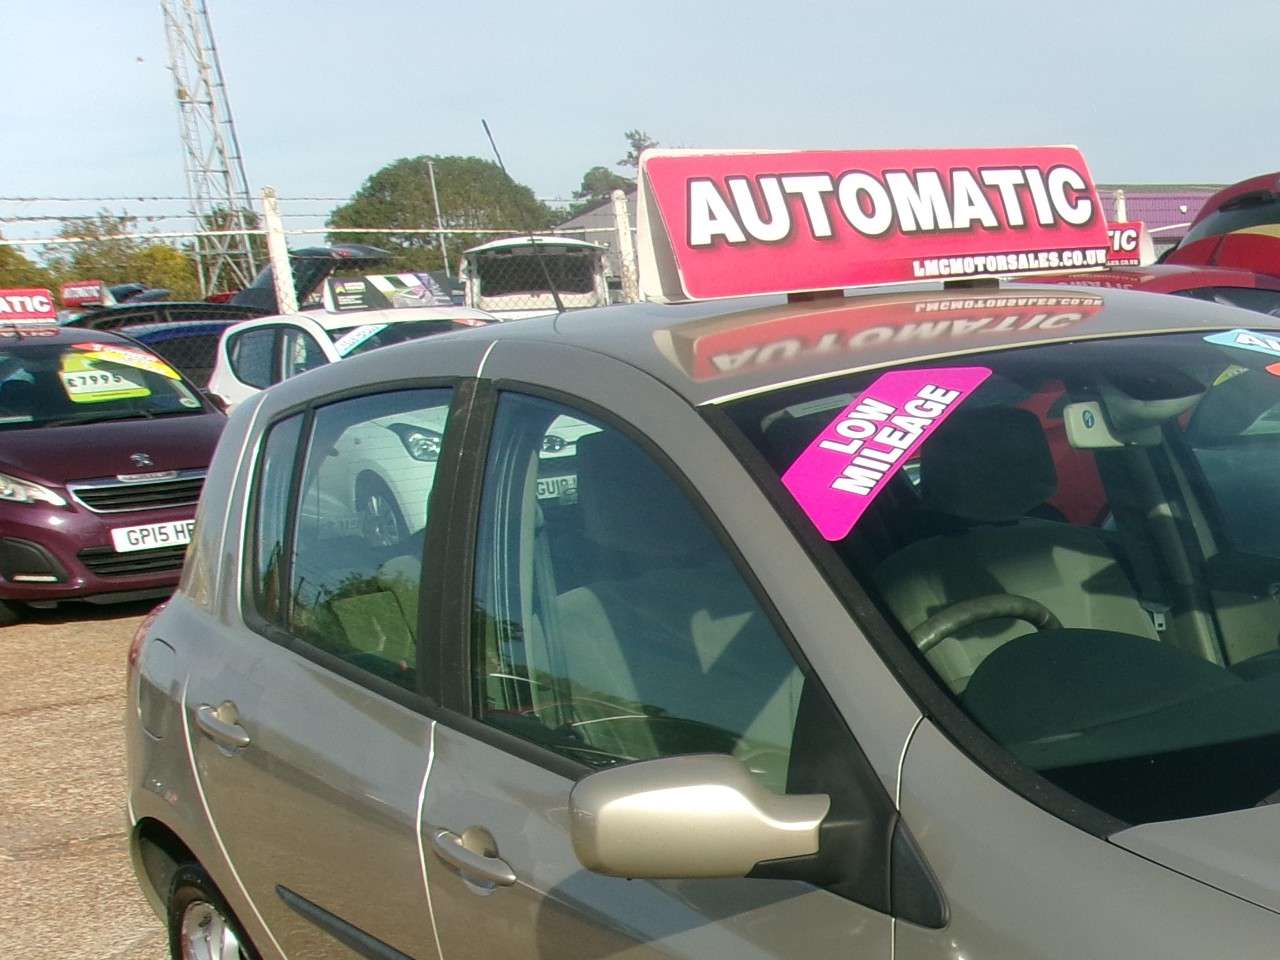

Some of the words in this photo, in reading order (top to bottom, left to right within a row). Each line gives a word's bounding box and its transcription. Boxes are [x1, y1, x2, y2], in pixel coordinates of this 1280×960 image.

[687, 165, 1094, 248] AUTOMATIC
[67, 373, 123, 387] £7995
[819, 397, 897, 455] LOW
[831, 384, 963, 496] MILEAGE
[127, 525, 169, 546] GP15
